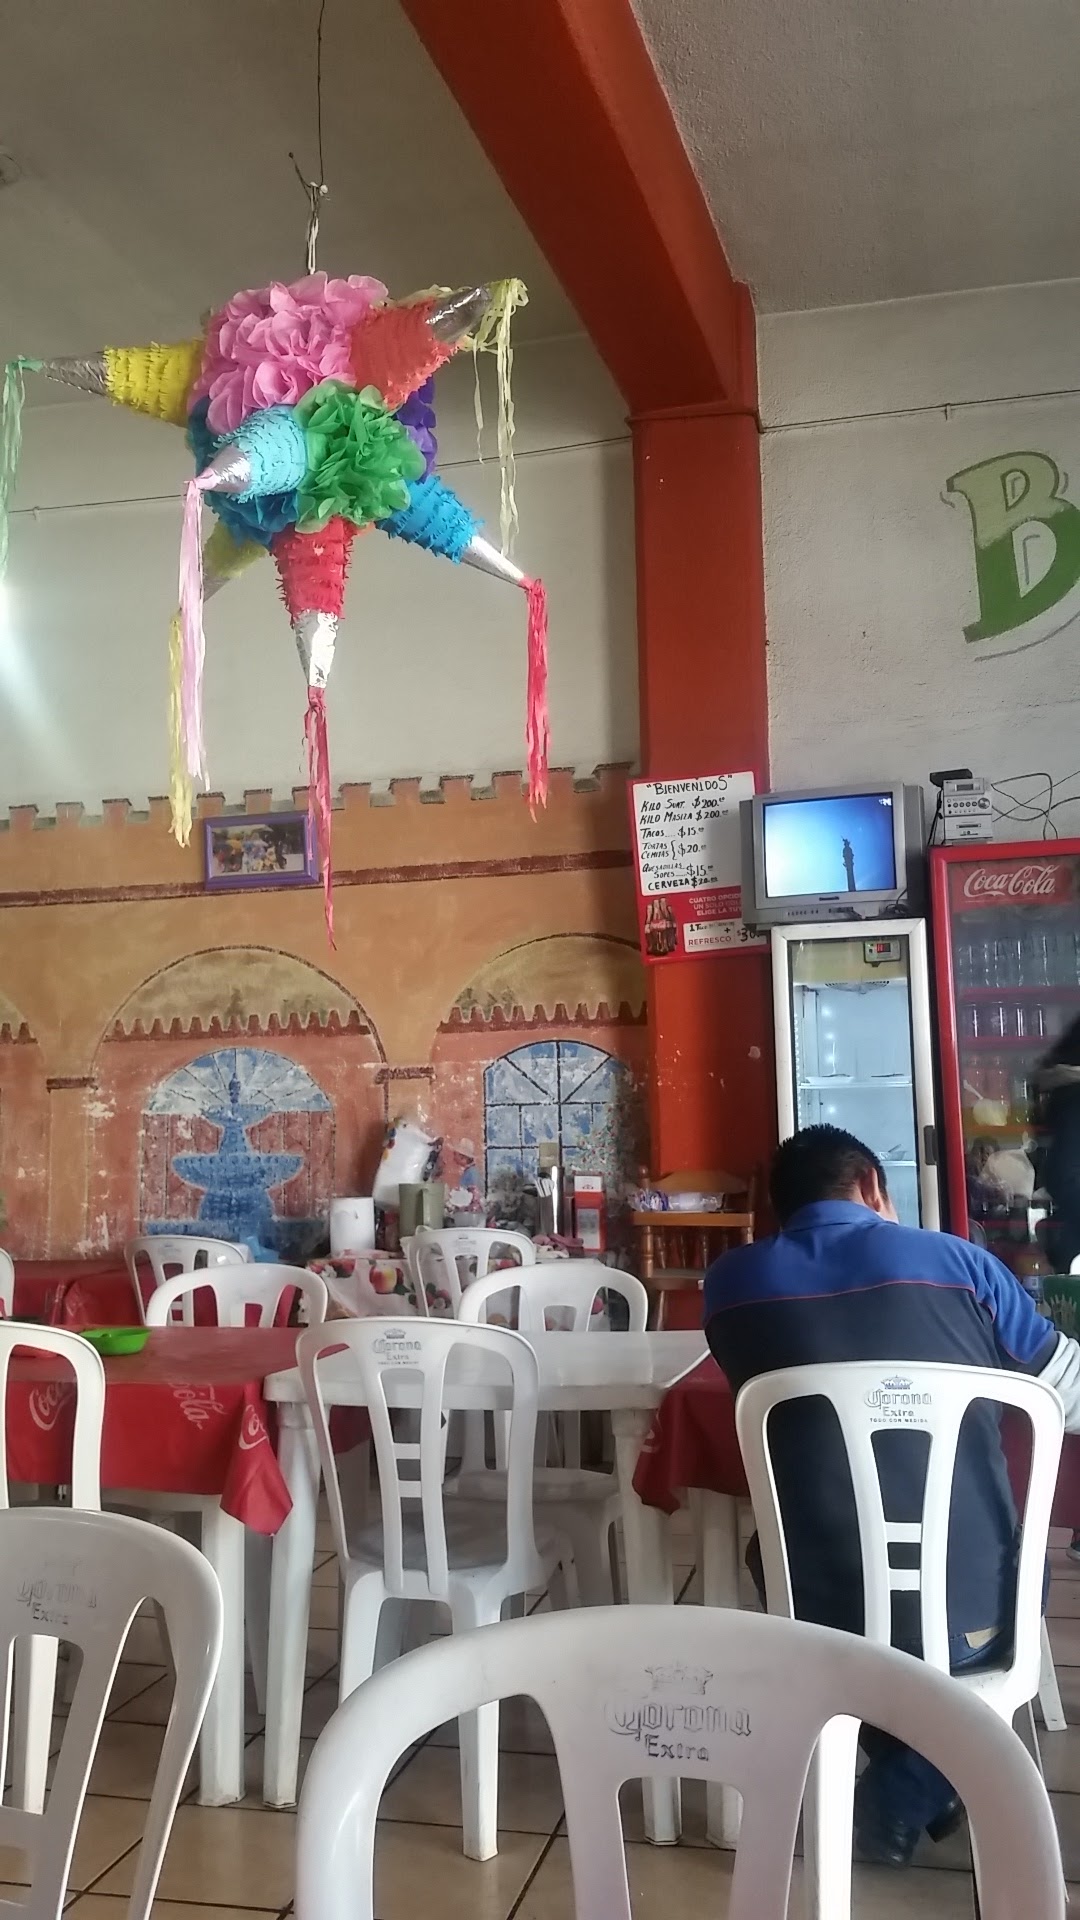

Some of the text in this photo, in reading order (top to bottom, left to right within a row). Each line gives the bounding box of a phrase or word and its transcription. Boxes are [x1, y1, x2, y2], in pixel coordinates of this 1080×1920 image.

[946, 451, 1080, 644] B
[641, 801, 661, 812] KILO
[640, 815, 661, 825] KILO
[648, 878, 690, 891] CERVEZA
[963, 865, 1060, 898] Coca-Cola
[689, 893, 741, 904] CUATRO OPCIO
[688, 935, 732, 946] REFRESCO
[373, 1339, 421, 1354] Corona
[864, 1388, 932, 1410] Corona
[882, 1406, 915, 1417] Extra
[603, 1697, 752, 1741] Corona
[644, 1733, 709, 1762] Extra
